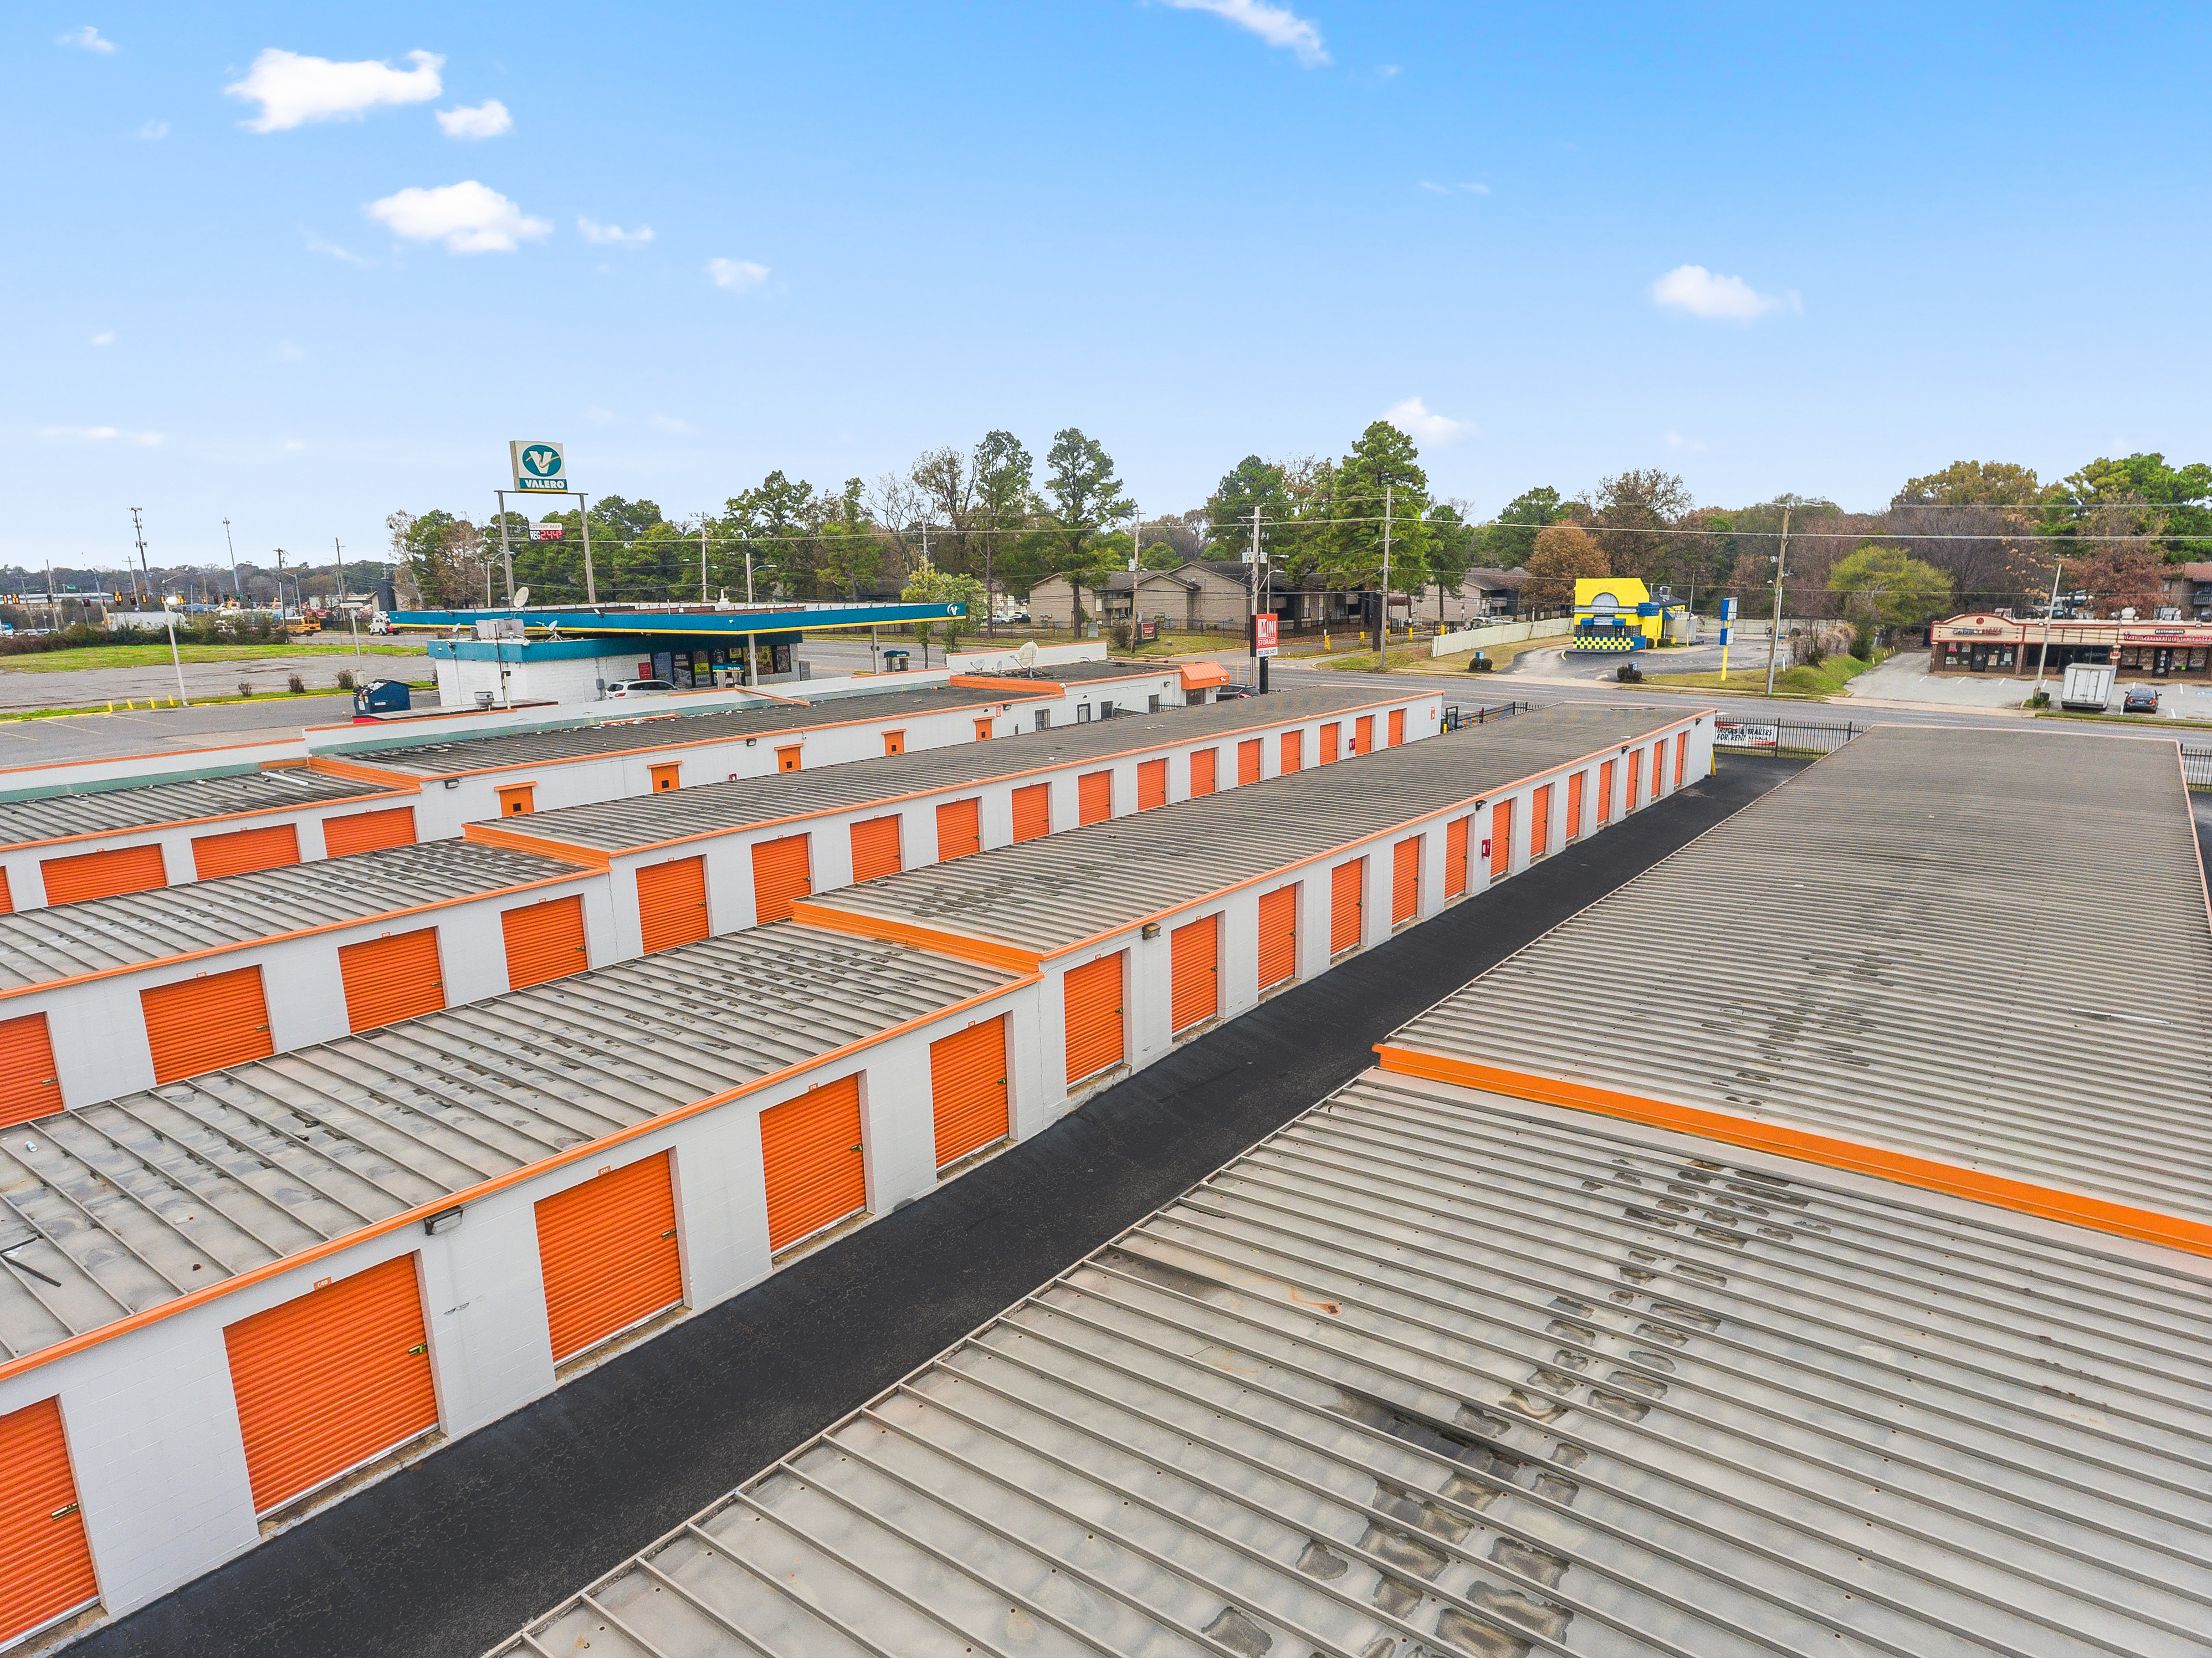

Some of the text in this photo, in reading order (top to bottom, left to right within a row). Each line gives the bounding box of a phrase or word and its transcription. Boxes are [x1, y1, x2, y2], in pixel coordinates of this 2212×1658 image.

[524, 479, 565, 489] VALERO
[530, 530, 540, 540] REG
[1257, 638, 1276, 646] STORAGE
